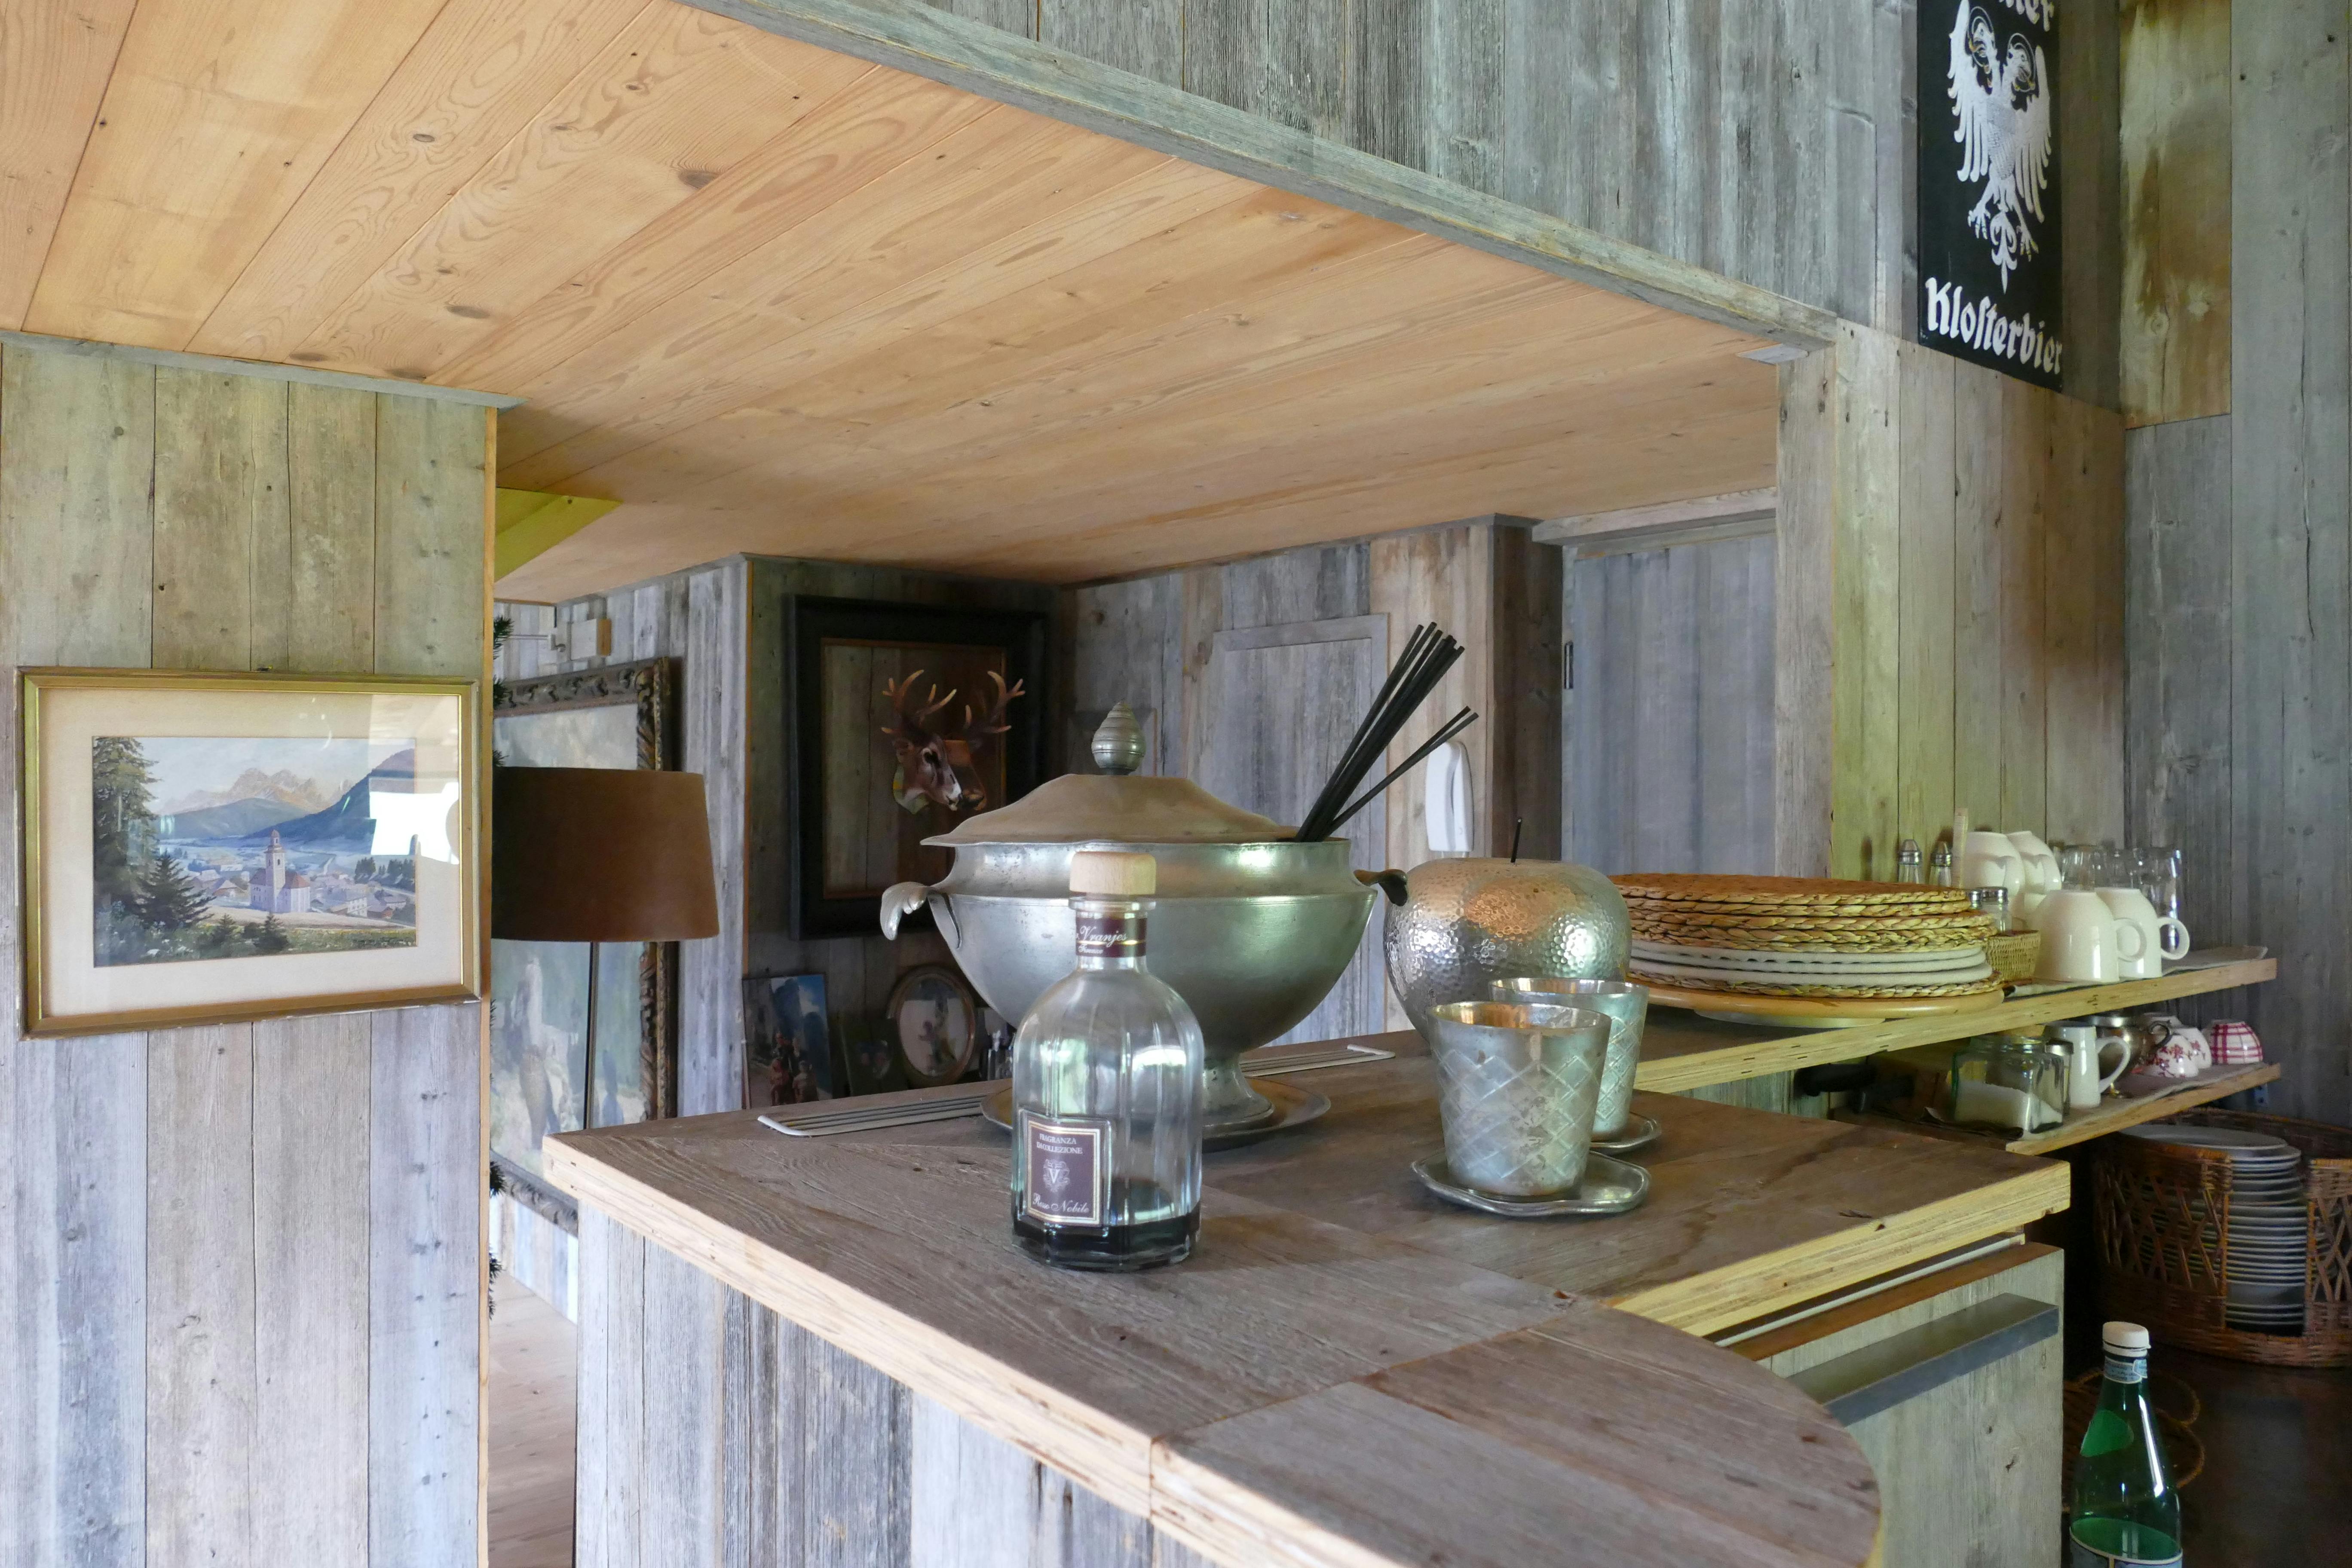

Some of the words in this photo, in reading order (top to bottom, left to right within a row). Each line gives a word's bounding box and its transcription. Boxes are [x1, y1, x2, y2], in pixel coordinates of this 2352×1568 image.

[1080, 925, 1127, 948] Vranjes
[1039, 1133, 1077, 1144] FRAGRANZA
[1050, 1200, 1090, 1213] Nobile
